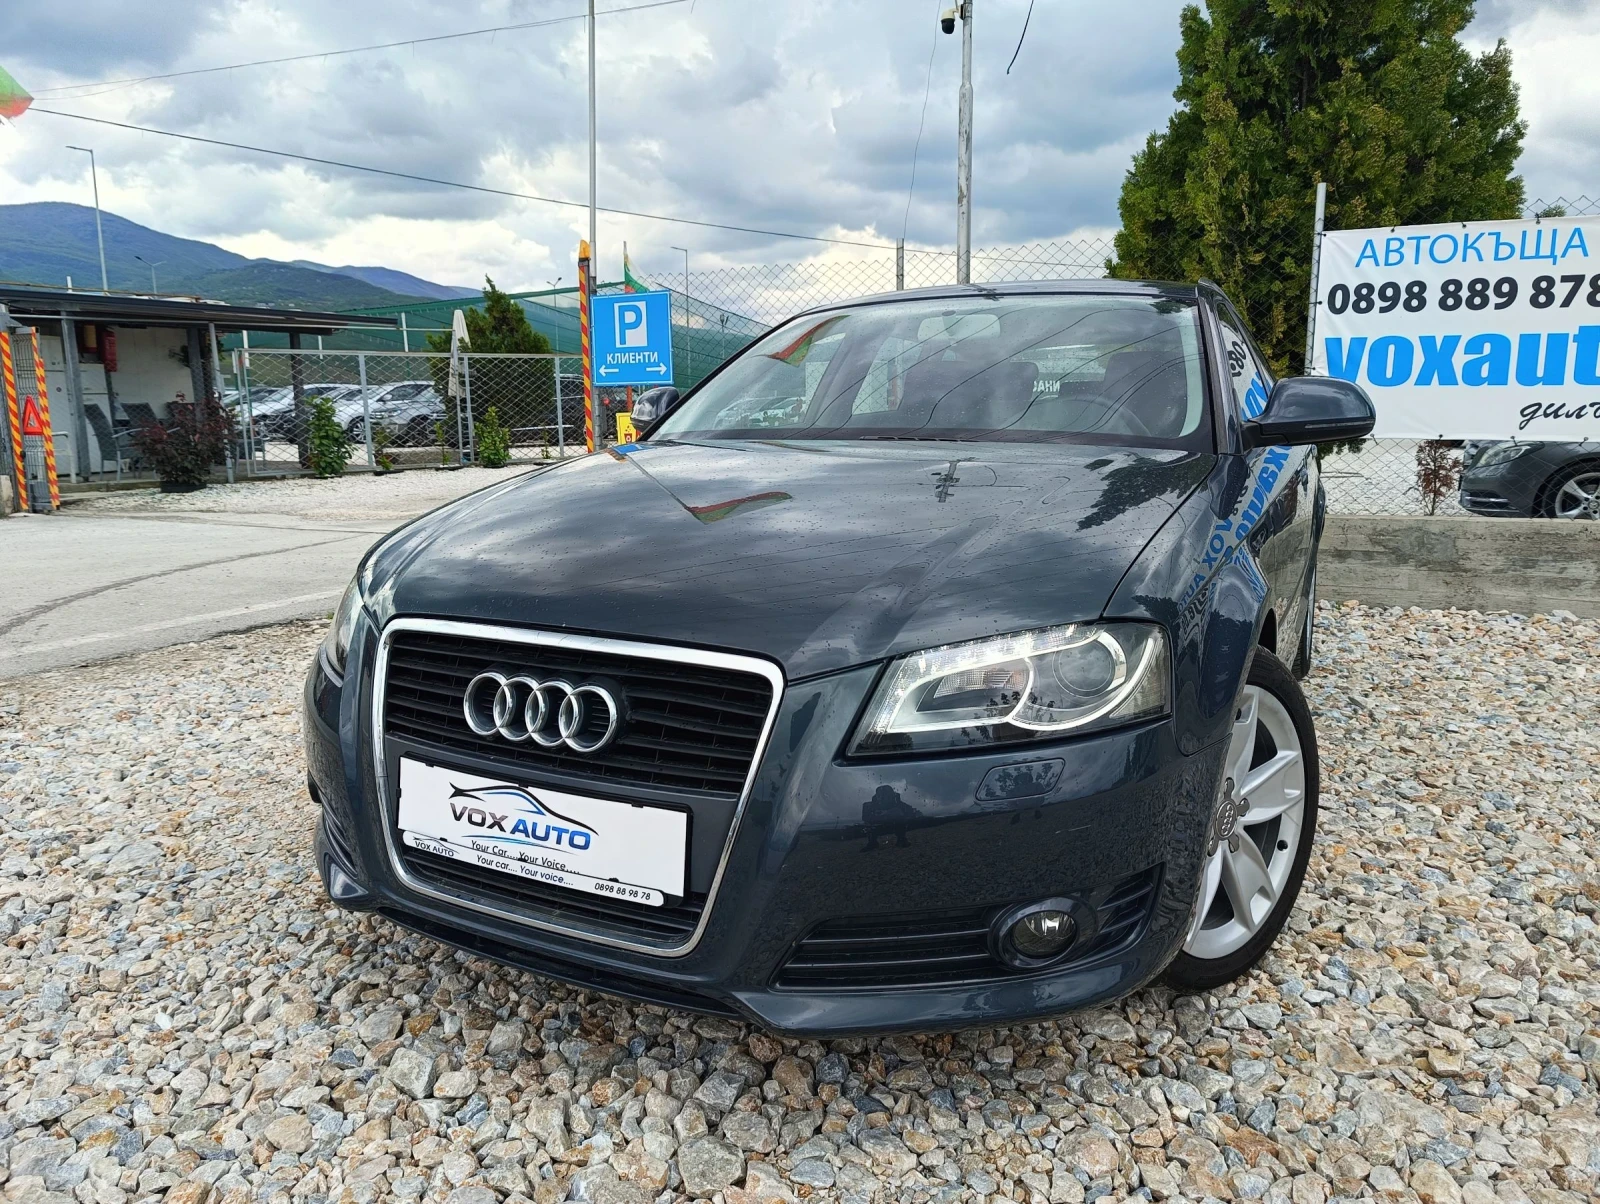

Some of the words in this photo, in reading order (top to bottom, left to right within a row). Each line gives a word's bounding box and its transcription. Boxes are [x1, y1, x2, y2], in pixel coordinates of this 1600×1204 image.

[1355, 227, 1589, 268] АВТОКЪЩА
[1327, 280, 1428, 315] 0898
[1438, 276, 1519, 312] 889
[607, 352, 658, 364] КЛИЕНТИ
[450, 803, 508, 833] VOX
[510, 818, 591, 850] AUTO
[415, 840, 431, 851] VOX
[433, 846, 455, 857] AUTO
[471, 840, 489, 853] Your
[519, 851, 539, 863] Your
[477, 855, 495, 867] Your
[520, 865, 539, 877] Your
[594, 882, 615, 893] 0898
[616, 887, 626, 896] 88
[628, 889, 639, 898] 98
[640, 891, 651, 901] 78
